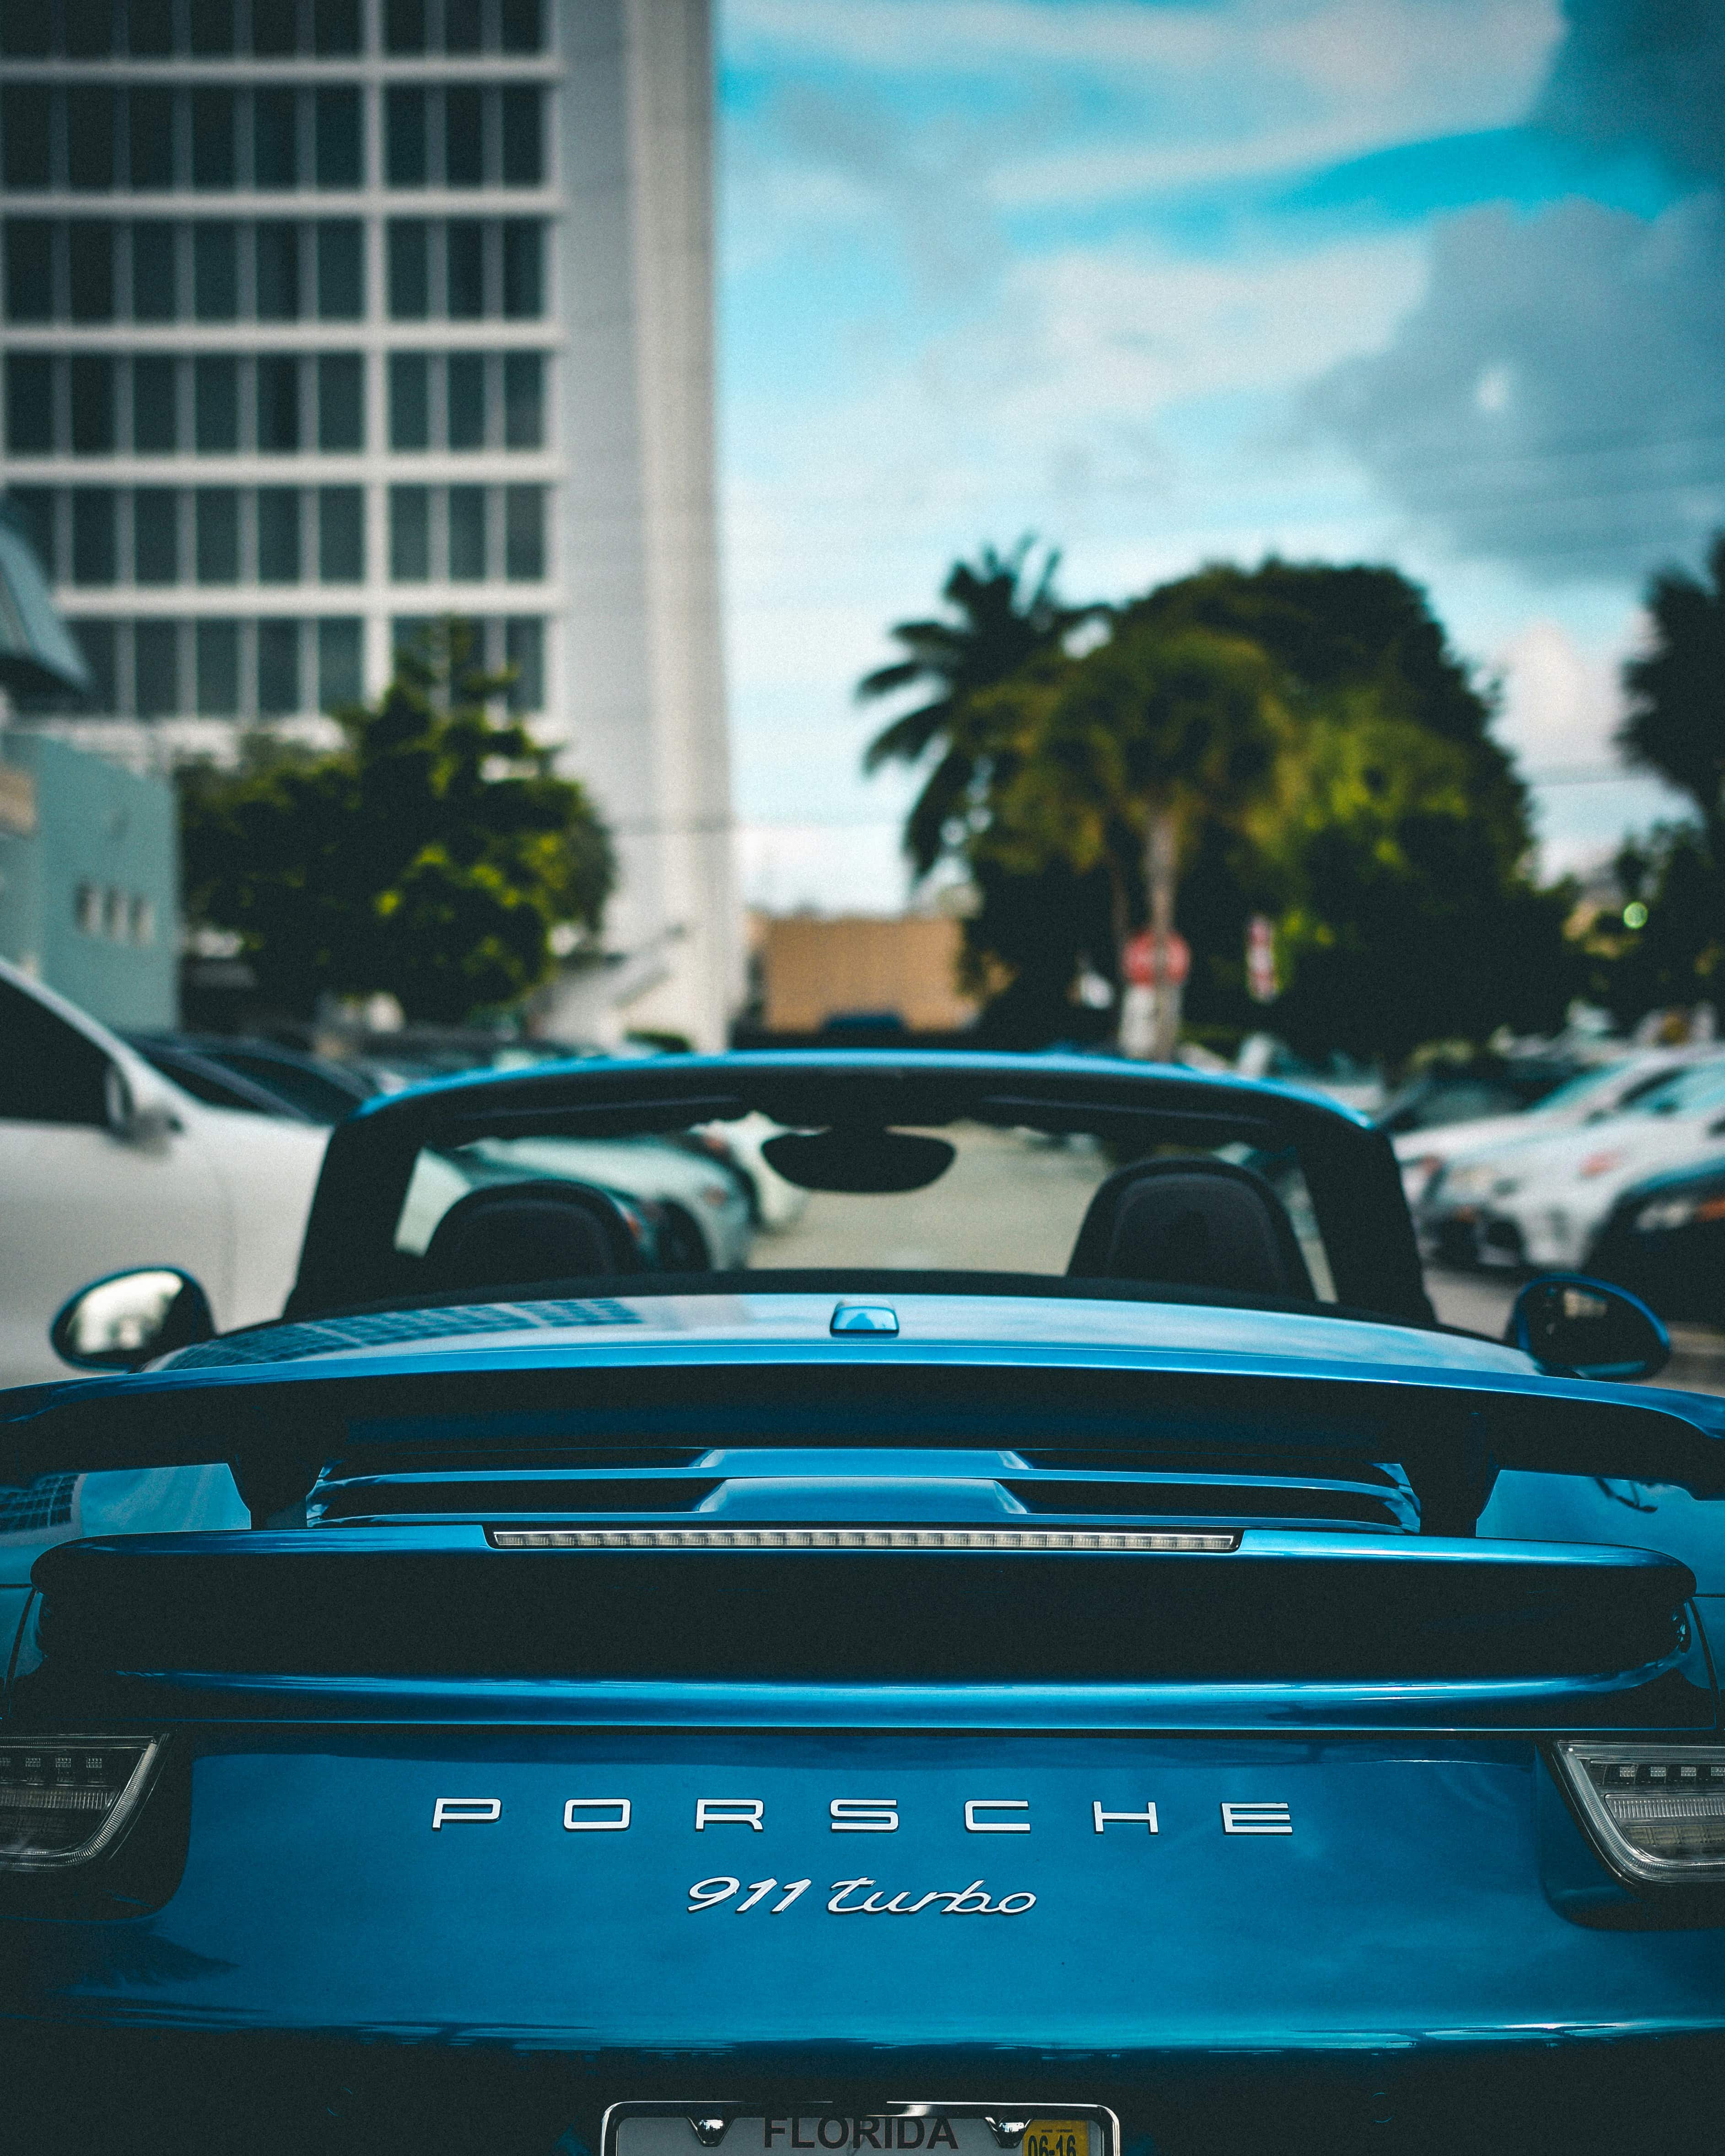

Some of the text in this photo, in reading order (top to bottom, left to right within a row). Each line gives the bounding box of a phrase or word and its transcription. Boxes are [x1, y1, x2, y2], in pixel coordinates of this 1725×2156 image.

[431, 1797, 1293, 1836] PORSCHE
[687, 1876, 1037, 1915] 911 turbo
[764, 2116, 960, 2149] FLORIDA
[1028, 2134, 1077, 2156] 06-16
